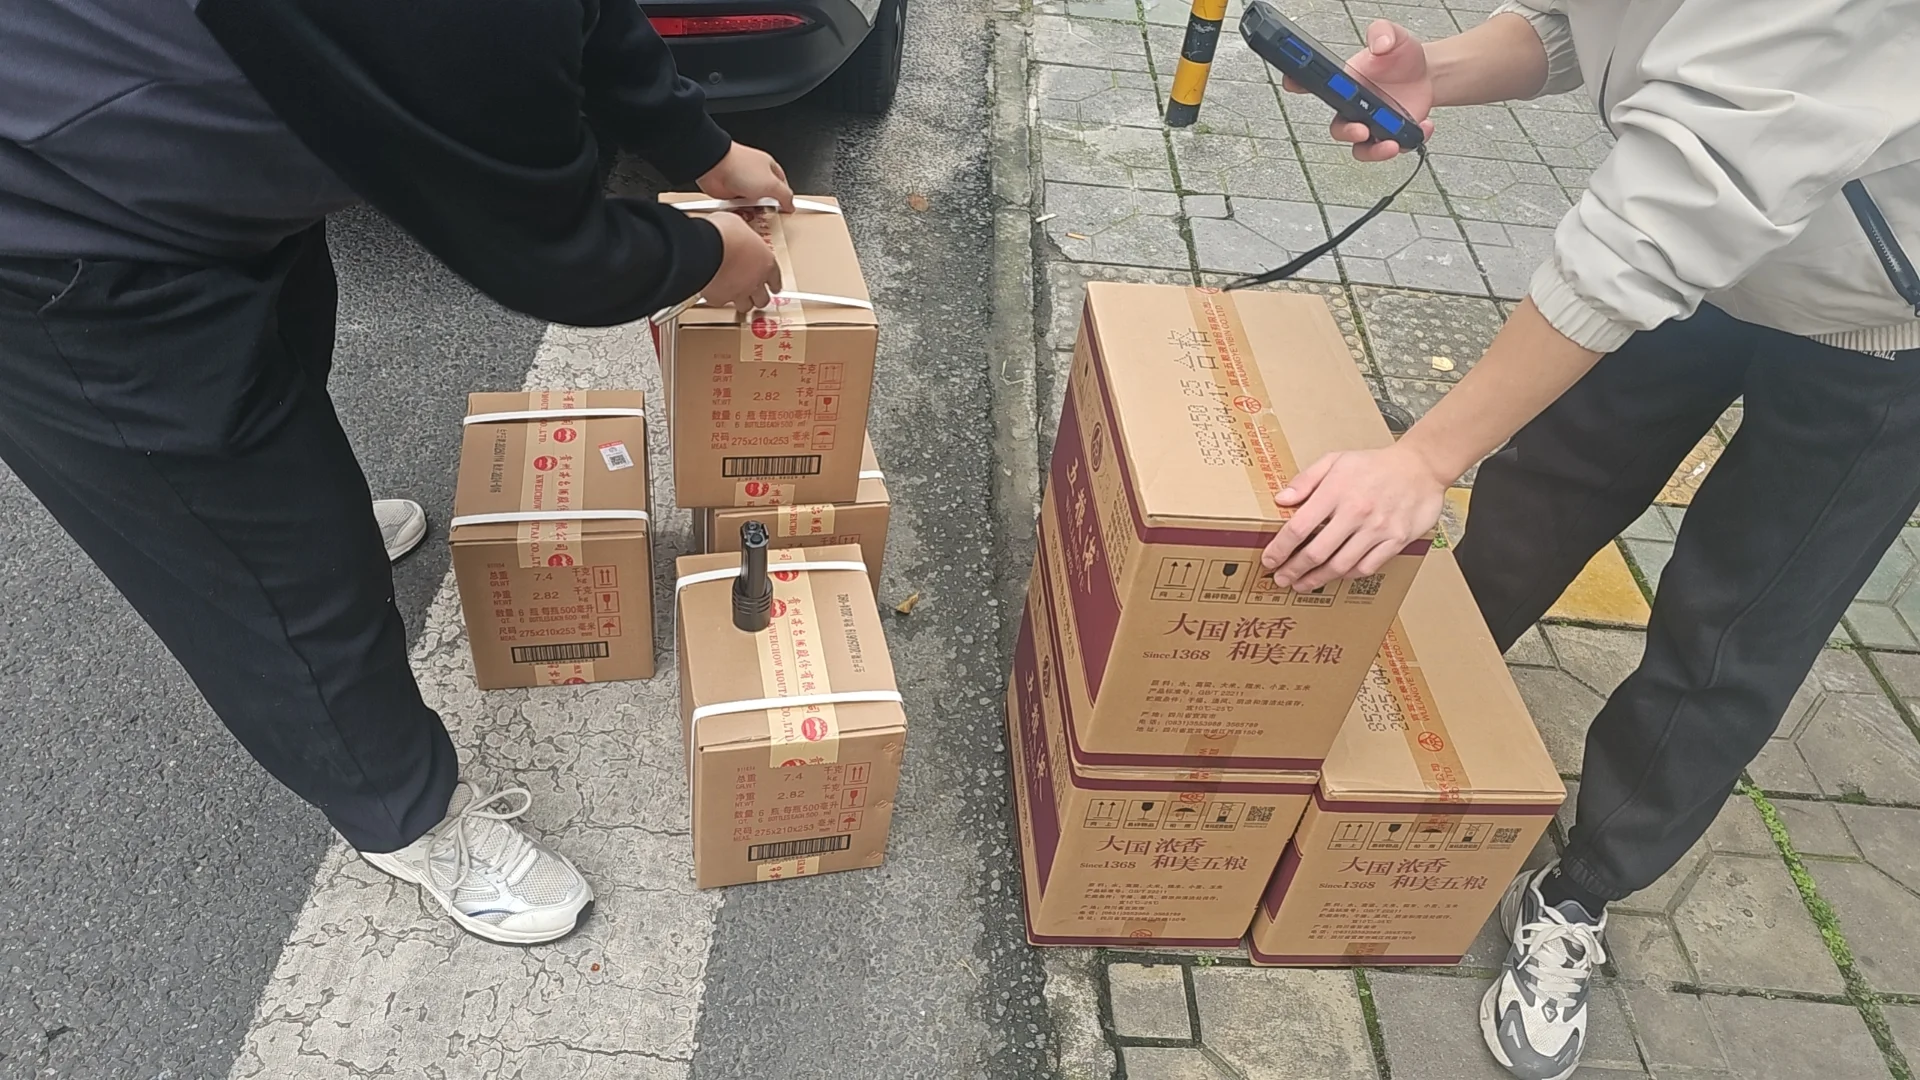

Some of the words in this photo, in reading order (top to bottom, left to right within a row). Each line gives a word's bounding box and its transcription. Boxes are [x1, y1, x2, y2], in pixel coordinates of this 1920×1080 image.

[1223, 329, 1236, 347] YIBIN
[1167, 328, 1220, 372] 合格
[713, 364, 733, 374] 总重
[759, 369, 778, 378] 7.4
[1229, 347, 1250, 388] WULIANGYE
[801, 377, 811, 385] kg
[1180, 379, 1204, 397] 25
[712, 388, 732, 397] 净重
[753, 392, 780, 401] 2.82
[712, 411, 731, 420] 数量
[735, 411, 741, 420] 6
[1205, 381, 1253, 467] 2025/04/17
[711, 433, 730, 442] 尺码
[731, 437, 789, 446] 275x210x253
[1269, 454, 1283, 474] YIBIN
[1066, 457, 1096, 595] 五粮液
[489, 571, 509, 580] 总重
[533, 573, 553, 581] 7.4
[572, 568, 591, 576] 千克
[493, 591, 512, 599] 净重
[533, 591, 559, 600] 2.82
[573, 586, 592, 595] 千克
[496, 609, 514, 617] 数量
[518, 609, 524, 617] 6
[529, 608, 539, 616] 瓶
[499, 626, 516, 635] 尺码
[519, 627, 576, 638] 275x210x253
[578, 622, 596, 631] 毫米
[1163, 612, 1298, 642] 大国浓香
[768, 622, 783, 667] KWEICHOW
[1226, 640, 1344, 665] 和美五粮
[1396, 657, 1410, 676] YIBIN
[1369, 652, 1409, 732] 2025/04/
[1405, 677, 1430, 722] WULIANGYE
[736, 774, 757, 783] 总重
[784, 773, 803, 782] 7.4
[824, 766, 843, 774] 千克
[735, 792, 756, 801] 净重
[777, 790, 805, 800] 2.82
[822, 784, 840, 793] 千克
[734, 810, 754, 818] 数量
[770, 808, 780, 816] 瓶
[733, 827, 753, 836] 尺码
[755, 823, 814, 837] 275x210x253
[817, 818, 836, 827] 毫米
[1096, 835, 1207, 856] 大国浓香
[1150, 855, 1249, 872] 和美五粮
[1338, 856, 1451, 876] 大国浓香
[1389, 875, 1489, 892] 和美五粮
